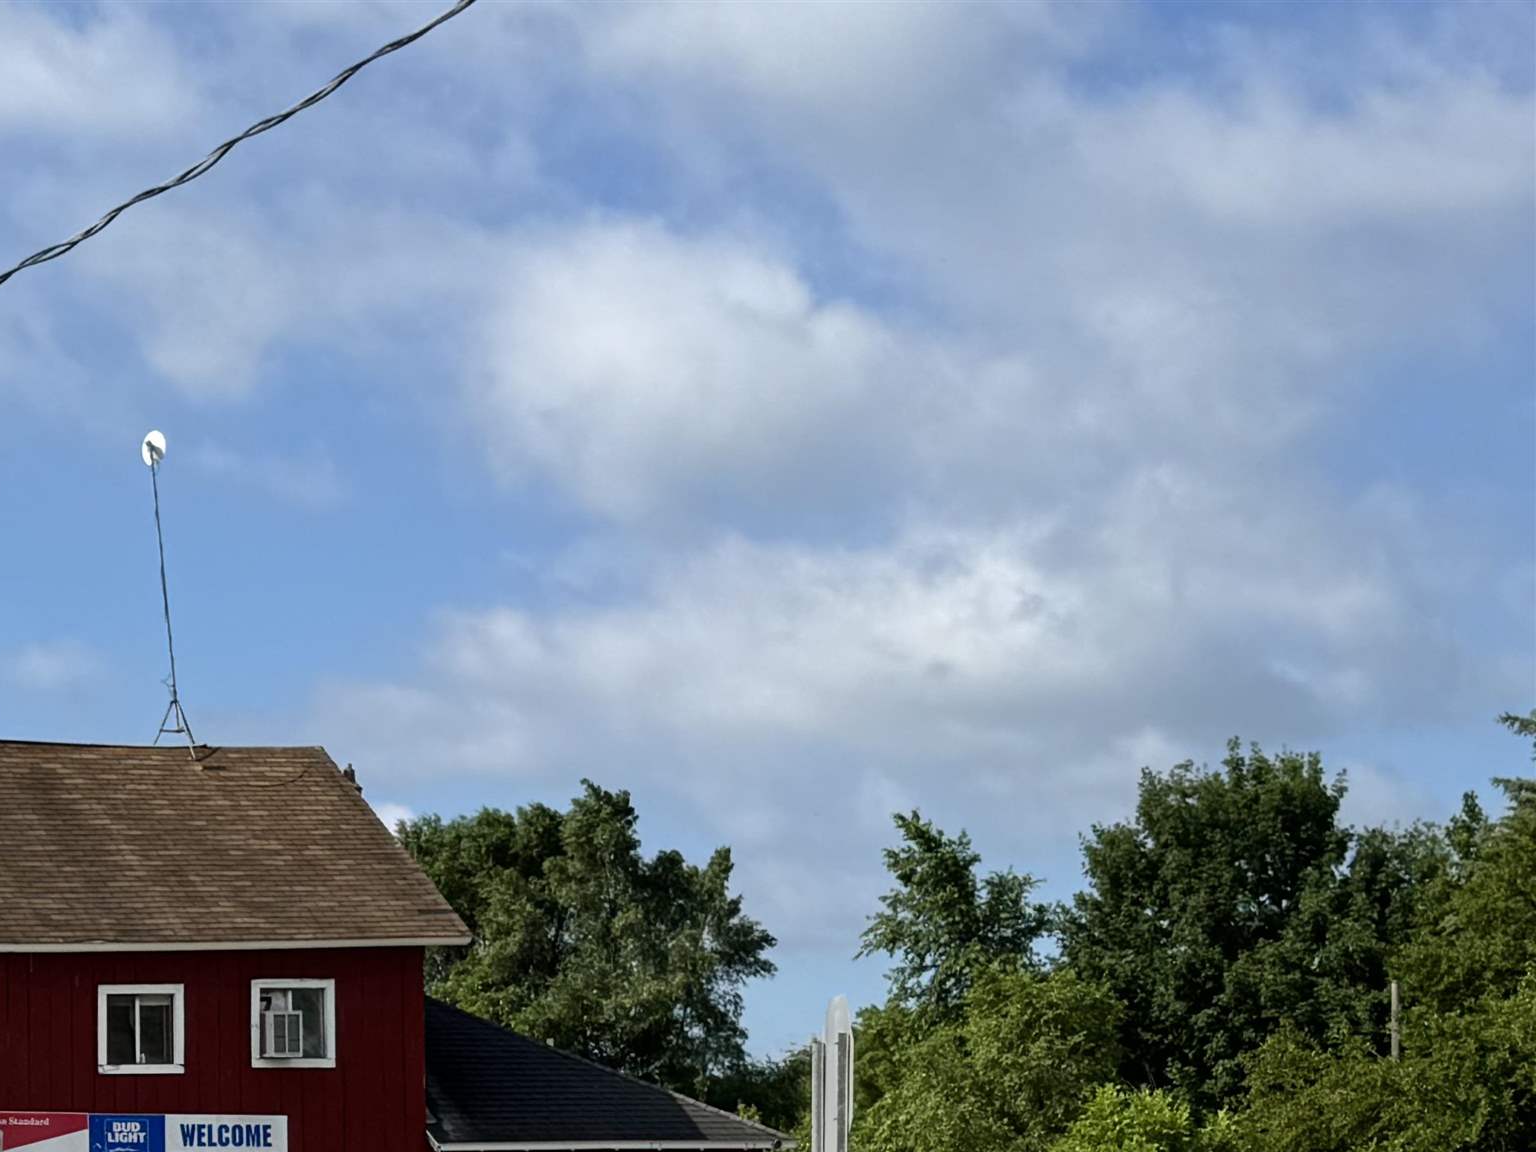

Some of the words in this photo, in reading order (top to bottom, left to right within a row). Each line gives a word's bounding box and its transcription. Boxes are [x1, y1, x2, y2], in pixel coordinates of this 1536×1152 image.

[8, 1116, 50, 1127] Standard
[112, 1121, 142, 1133] BUD
[107, 1132, 147, 1144] LIGHT
[179, 1123, 273, 1147] WELCOME
